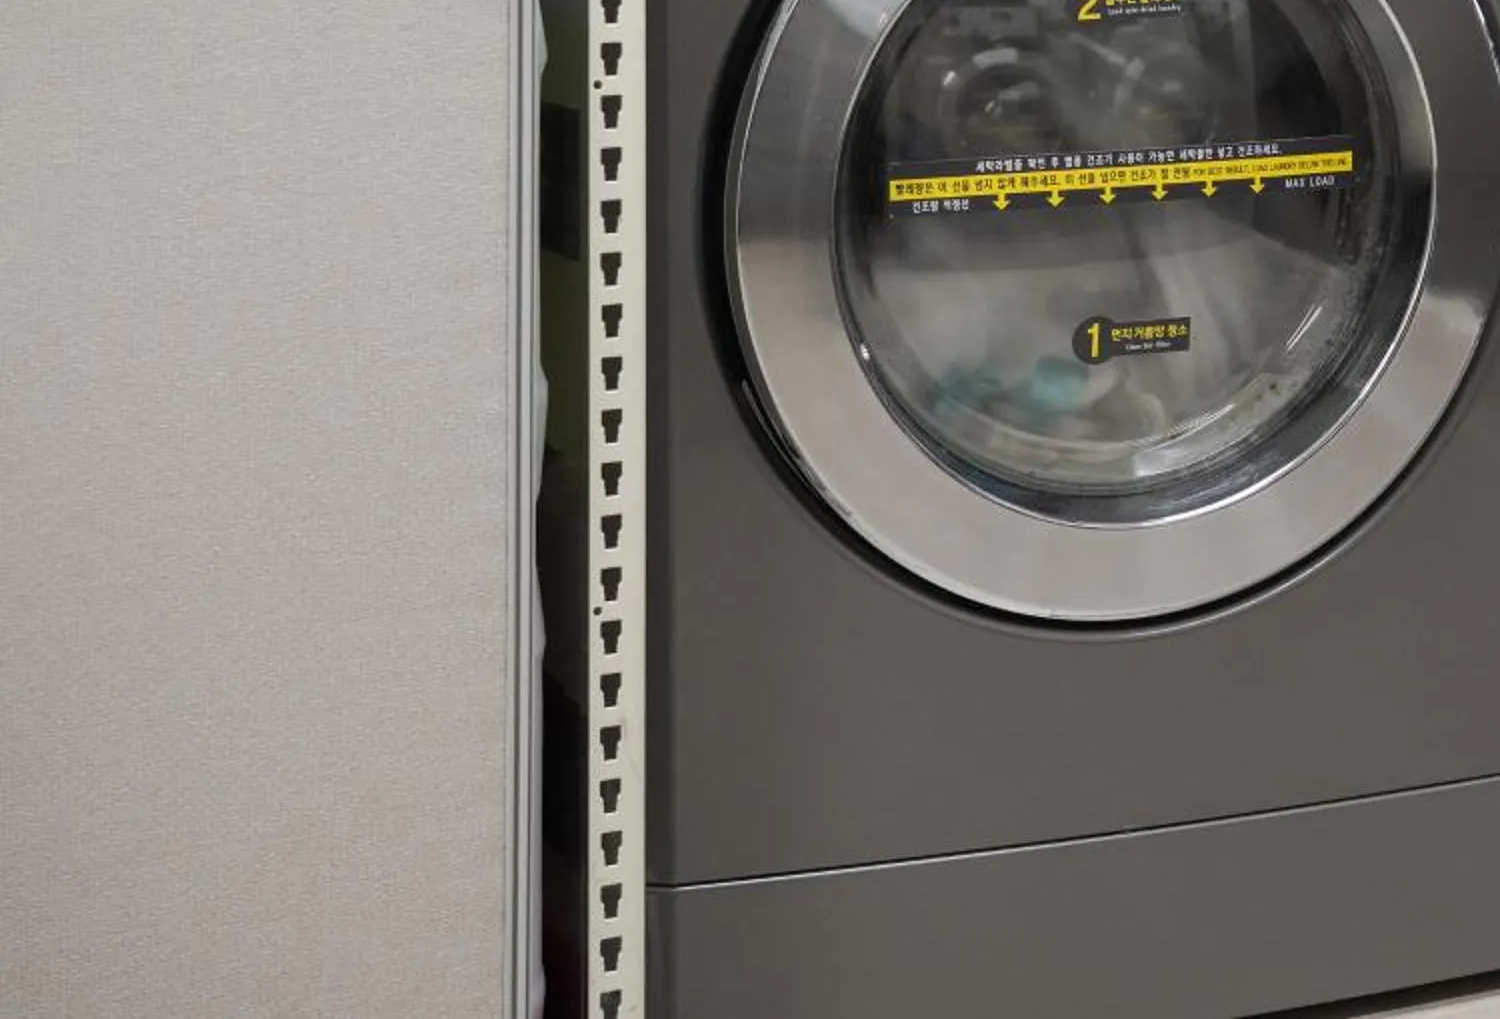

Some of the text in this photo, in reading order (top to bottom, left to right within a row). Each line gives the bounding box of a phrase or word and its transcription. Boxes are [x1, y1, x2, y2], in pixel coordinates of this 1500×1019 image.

[975, 158, 1023, 173] 세탁라벨을
[1285, 175, 1335, 189] MAX LOAD
[1088, 322, 1100, 358] 1
